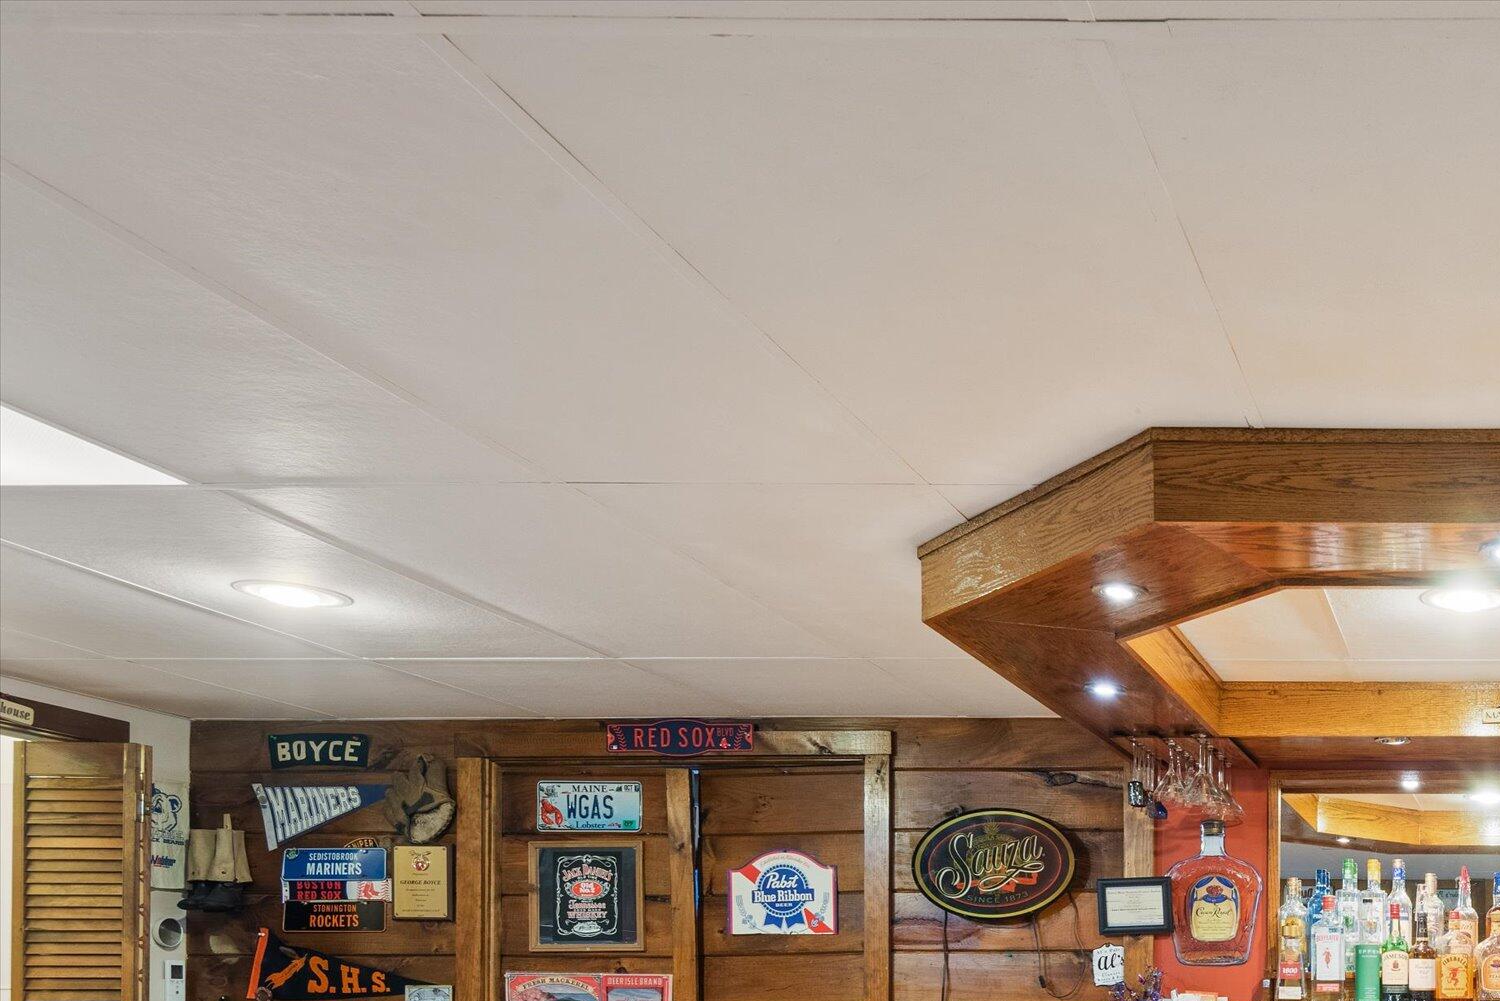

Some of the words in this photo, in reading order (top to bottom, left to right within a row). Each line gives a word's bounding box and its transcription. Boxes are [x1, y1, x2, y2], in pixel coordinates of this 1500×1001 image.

[633, 727, 671, 748] RED
[678, 727, 716, 748] SOX
[717, 727, 734, 737] BLVD
[276, 740, 362, 762] BOYCE
[571, 785, 608, 793] MAINE
[566, 794, 614, 819] WGAS
[264, 786, 362, 843] MARINERS
[575, 820, 606, 829] Lobster
[306, 862, 362, 875] MARINERS
[936, 832, 1044, 899] Sauza
[296, 880, 342, 890] BOSTON
[765, 872, 799, 889] Pabst
[296, 891, 317, 900] RED
[320, 891, 341, 900] SOX
[754, 890, 776, 902] Blue
[777, 888, 813, 901] Ribbon
[967, 894, 1001, 904] SINCE
[313, 904, 357, 912] STONINGTON
[309, 914, 360, 928] ROCKETS
[522, 977, 547, 989] FRESH
[549, 977, 590, 991] MACKEREL
[607, 977, 622, 985] DEER
[623, 977, 637, 985] ISLE
[638, 977, 662, 985] BRAND
